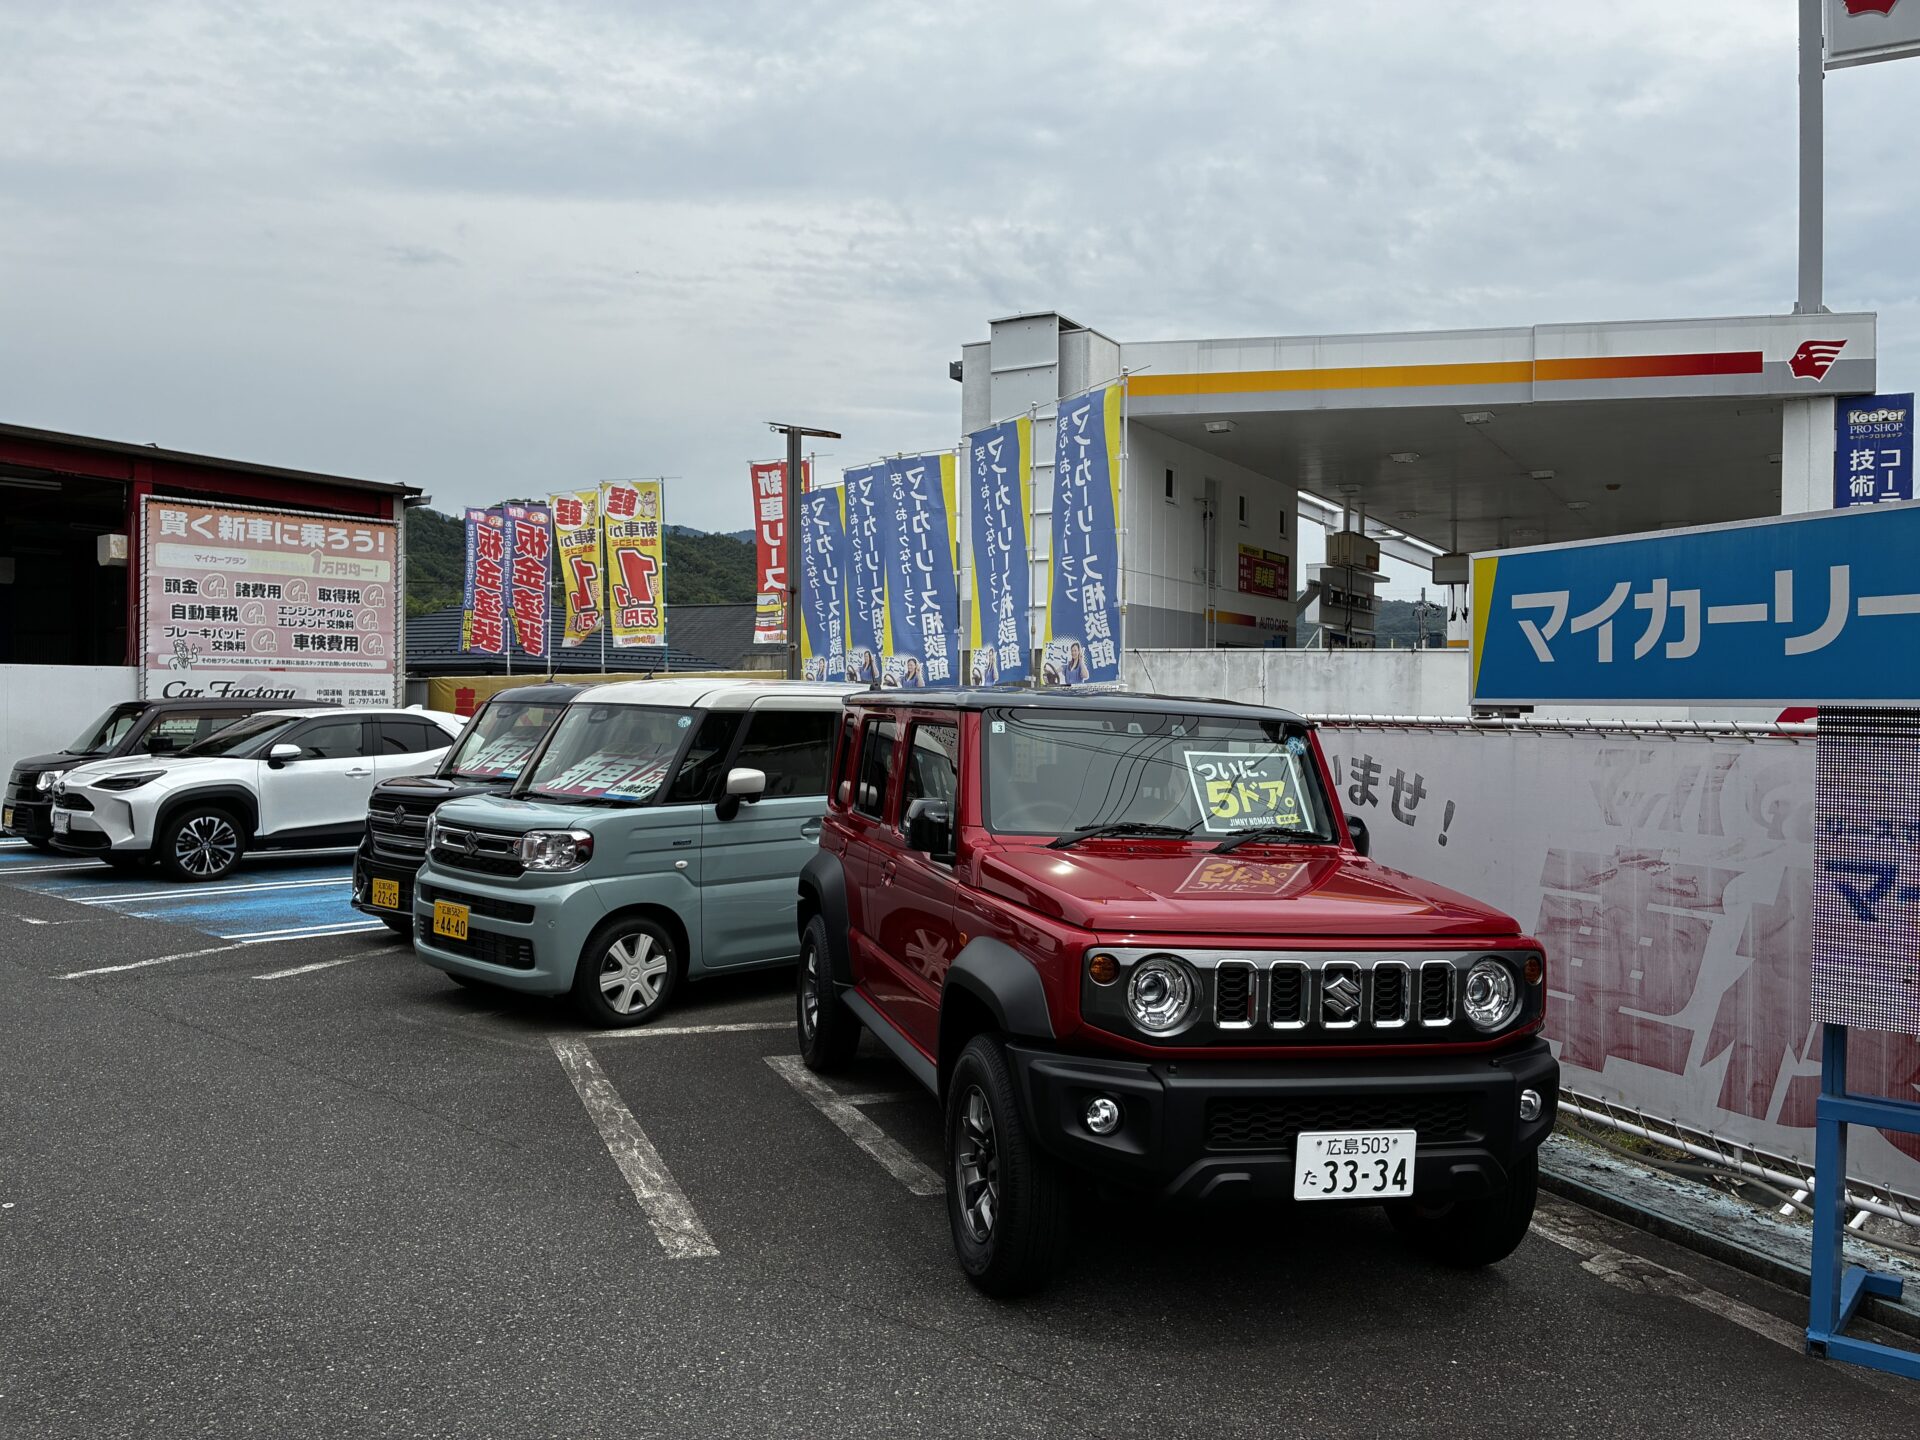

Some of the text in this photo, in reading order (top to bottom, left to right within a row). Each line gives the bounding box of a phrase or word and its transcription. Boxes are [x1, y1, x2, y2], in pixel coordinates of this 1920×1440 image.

[1849, 408, 1905, 424] KeePer
[1849, 423, 1903, 434] PRO SHOP
[1849, 448, 1875, 506] 技術
[159, 509, 386, 554] 賢く新車に乗ろう！
[194, 553, 247, 566] マイカープラン
[163, 577, 199, 595] 頭金
[234, 582, 282, 600] 諸費用
[317, 587, 361, 605] 取得税
[171, 603, 239, 623] 自動車税
[1511, 564, 1920, 664] マイカーリー
[277, 617, 355, 630] エレメント交換料
[1259, 616, 1289, 633] AUTO CARE
[163, 626, 246, 640] ブレーキパッド
[211, 639, 247, 652] 交換料
[292, 633, 360, 652] 車検費用
[163, 680, 204, 699] Car
[209, 681, 297, 700] Factory
[316, 689, 386, 697] 中国運輸 指定整備工場
[1196, 760, 1268, 781] ついに、
[1206, 779, 1296, 818] 5ドア。
[1229, 817, 1249, 827] JIMNY
[1249, 816, 1276, 826] NOMADE
[377, 890, 397, 907] 22-65
[440, 916, 466, 937] 44-40
[1326, 1137, 1390, 1156] 広島503
[1302, 1158, 1407, 1194] た 33-34
